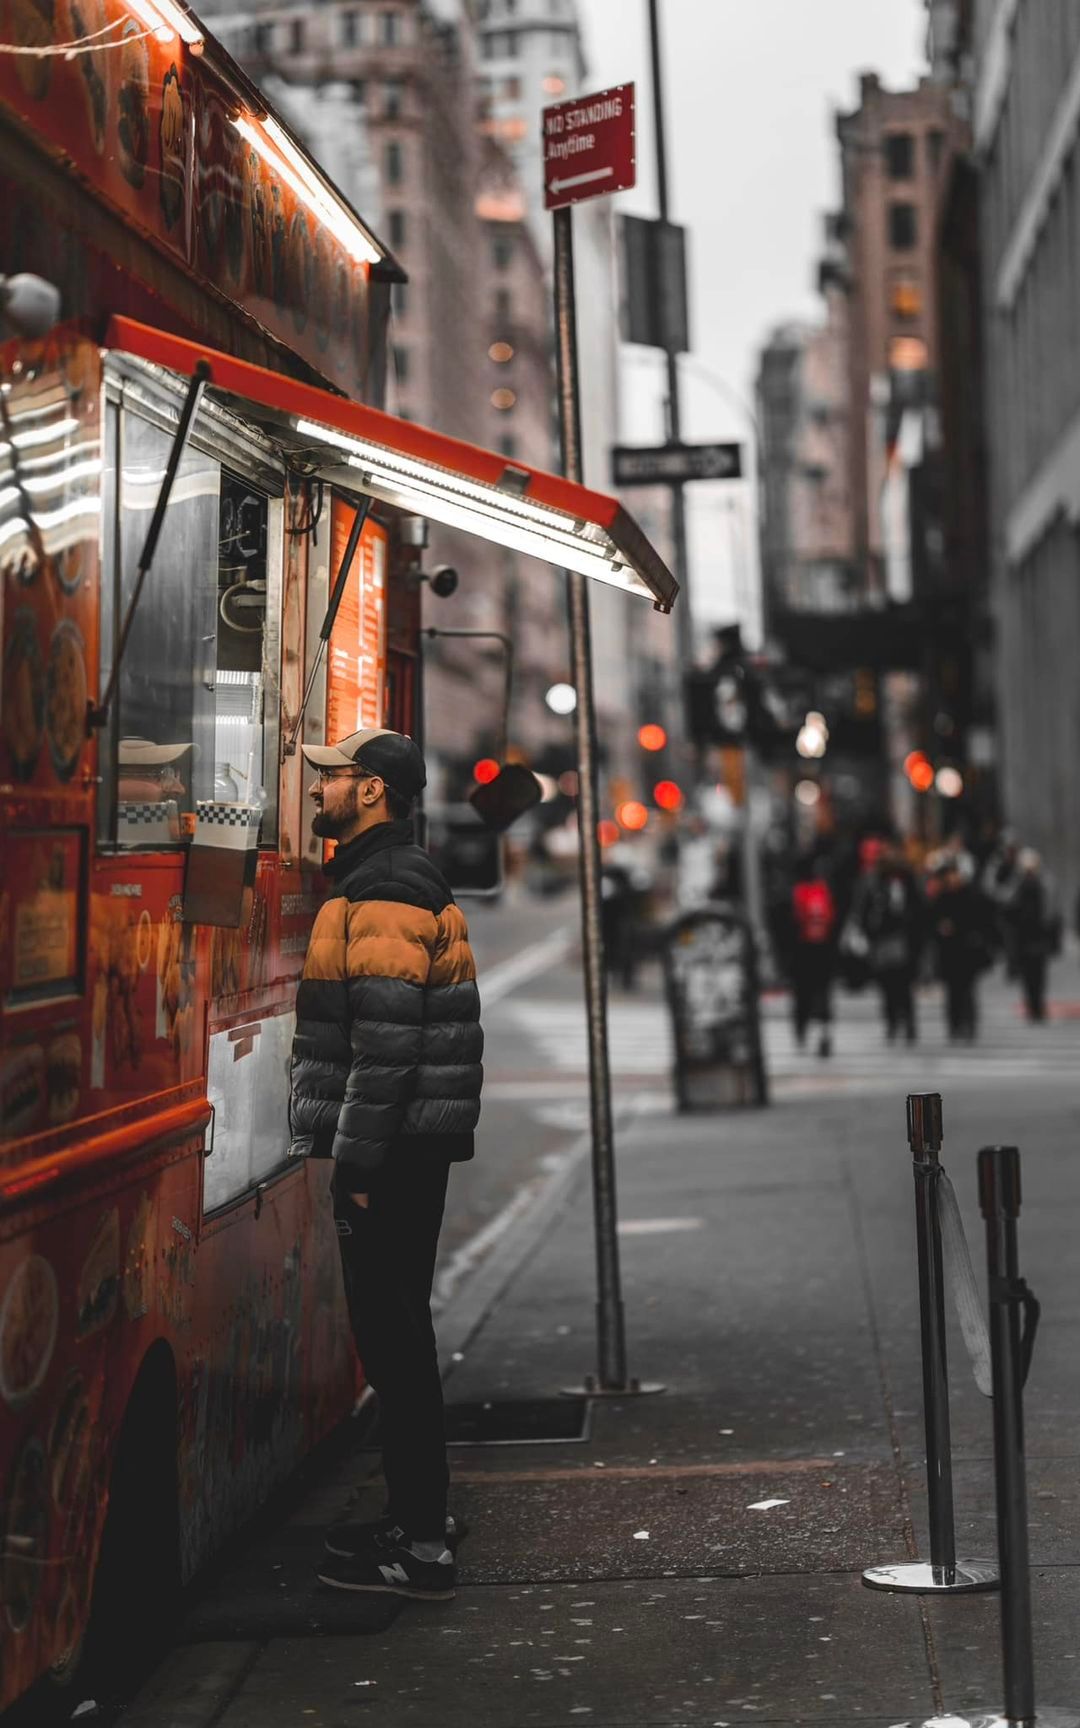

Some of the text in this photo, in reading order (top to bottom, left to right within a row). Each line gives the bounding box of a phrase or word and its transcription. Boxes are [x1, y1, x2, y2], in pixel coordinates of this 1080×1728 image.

[546, 97, 622, 135] NO STANDING
[548, 133, 595, 160] Anytime
